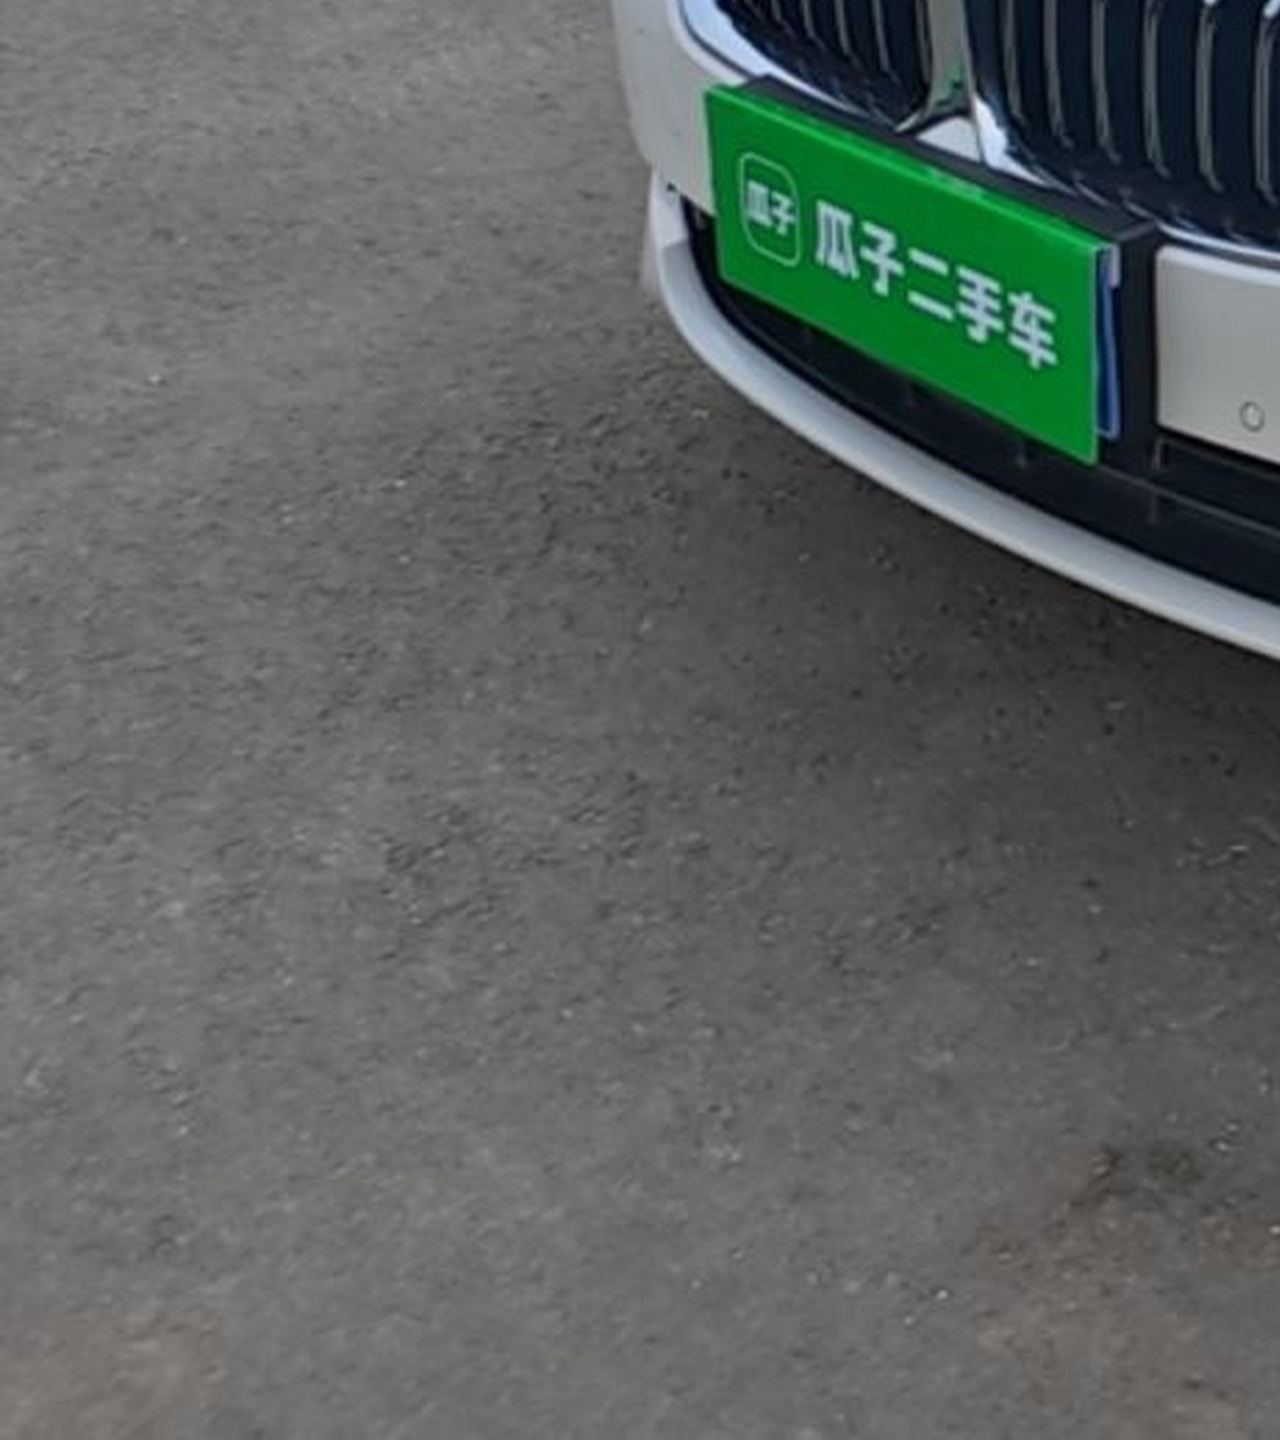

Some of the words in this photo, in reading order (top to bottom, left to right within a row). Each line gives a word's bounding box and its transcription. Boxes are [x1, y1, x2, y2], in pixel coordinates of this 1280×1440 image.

[815, 199, 1058, 369] 瓜子二手车
